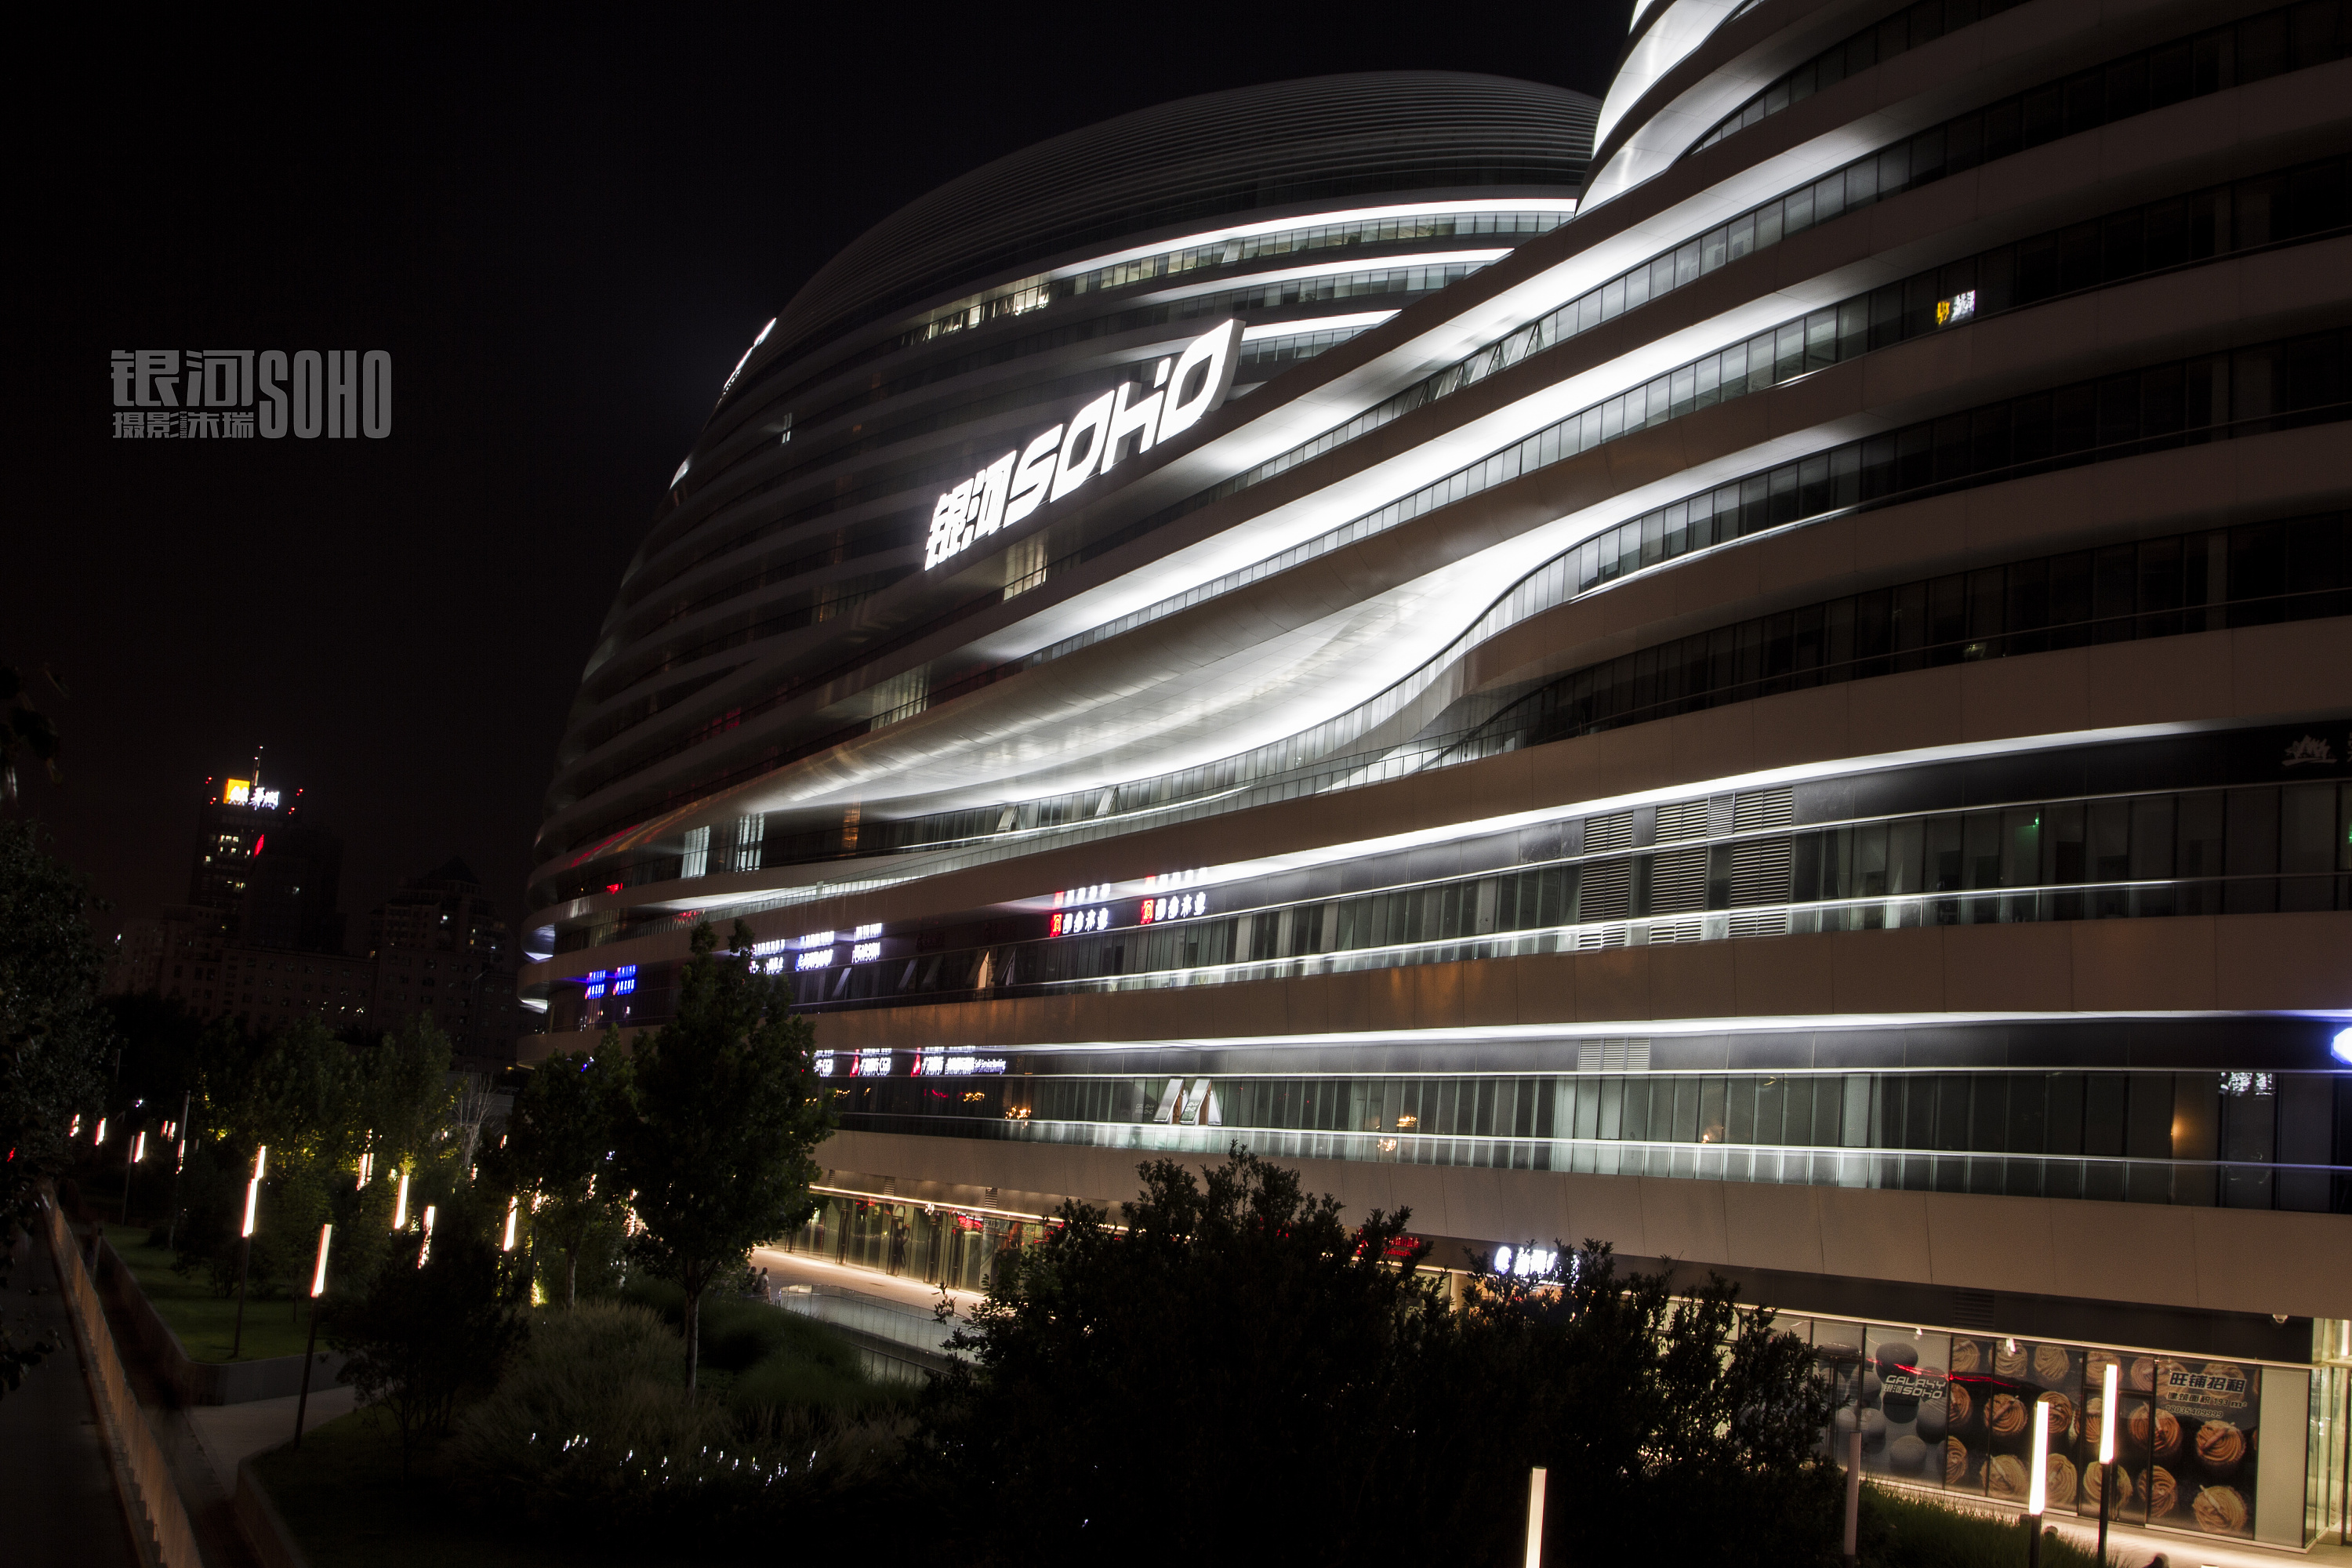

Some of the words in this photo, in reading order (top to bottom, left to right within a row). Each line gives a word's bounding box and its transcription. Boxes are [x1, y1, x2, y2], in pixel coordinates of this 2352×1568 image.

[1886, 1374, 1946, 1390] GALAXY
[2169, 1371, 2247, 1393] 旺铺招租
[2212, 1398, 2230, 1406] 193
